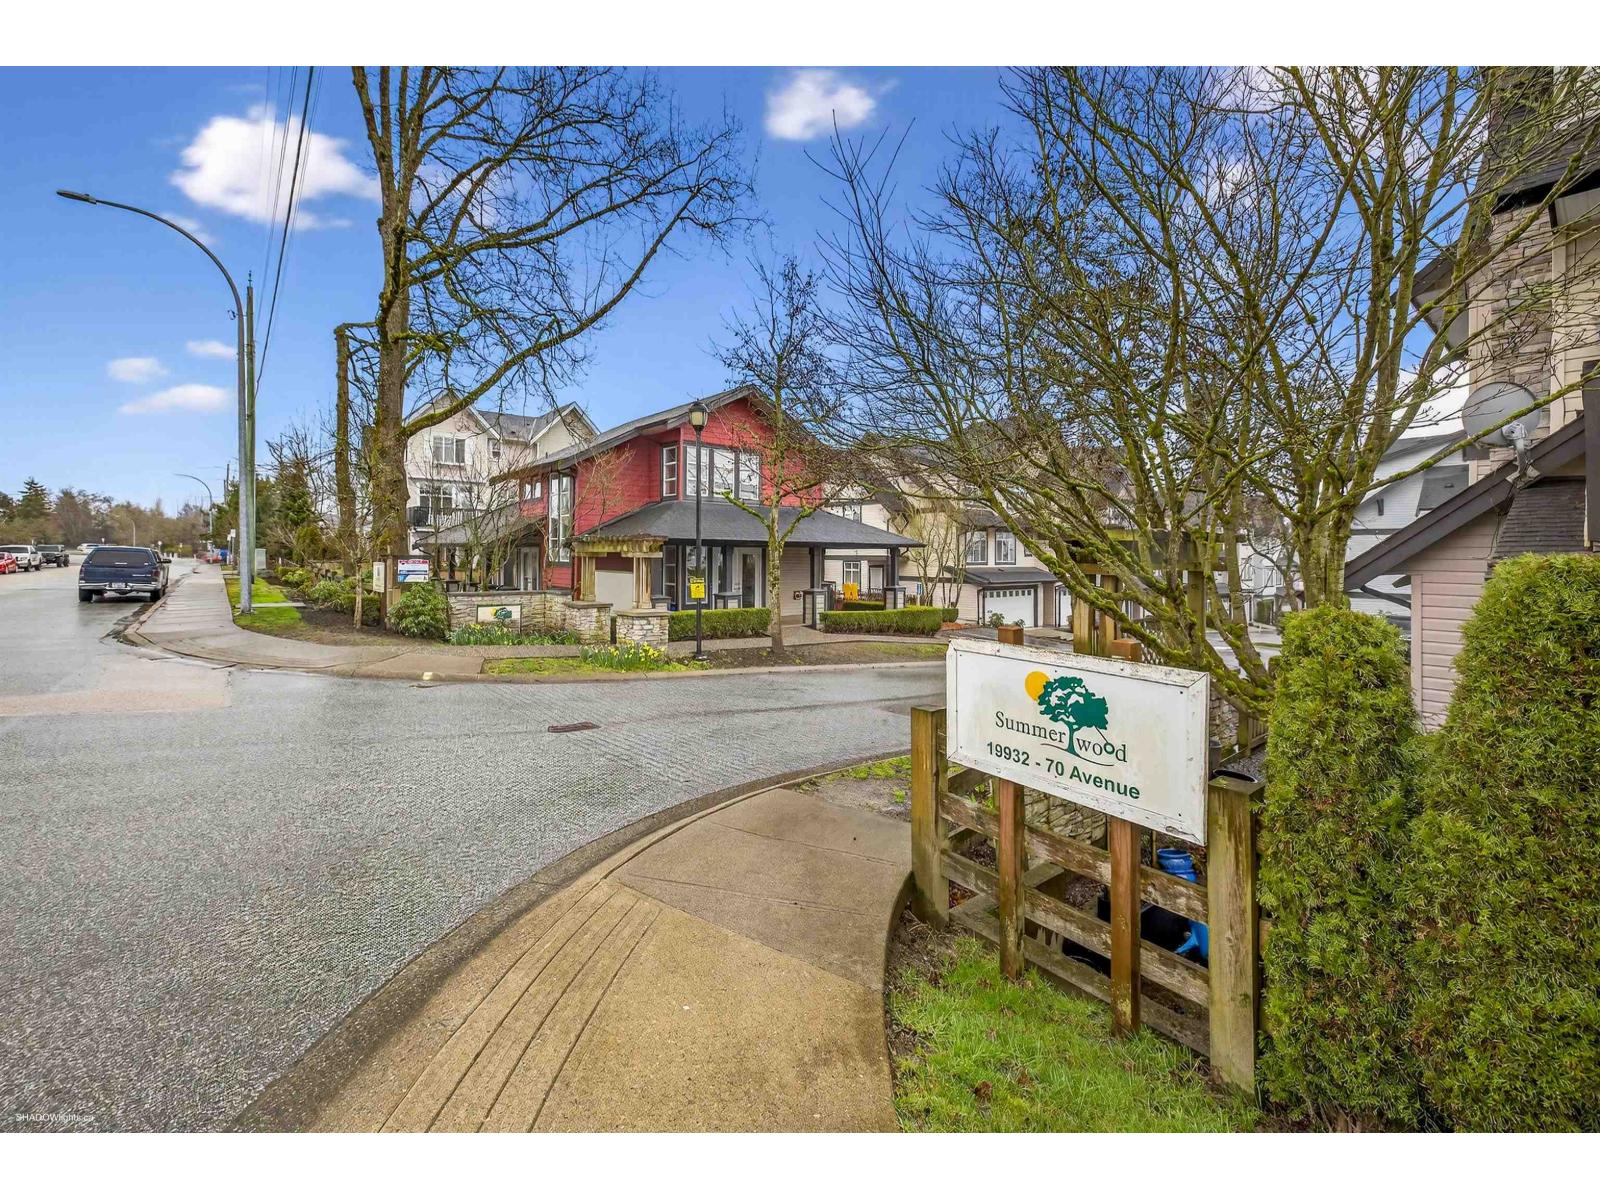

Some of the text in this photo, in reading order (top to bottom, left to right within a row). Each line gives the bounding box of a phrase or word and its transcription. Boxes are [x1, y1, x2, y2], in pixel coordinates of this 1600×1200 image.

[995, 710, 1066, 744] Summer
[986, 741, 1030, 767] 19932
[1045, 758, 1065, 777] 70
[1069, 765, 1141, 800] Avenue
